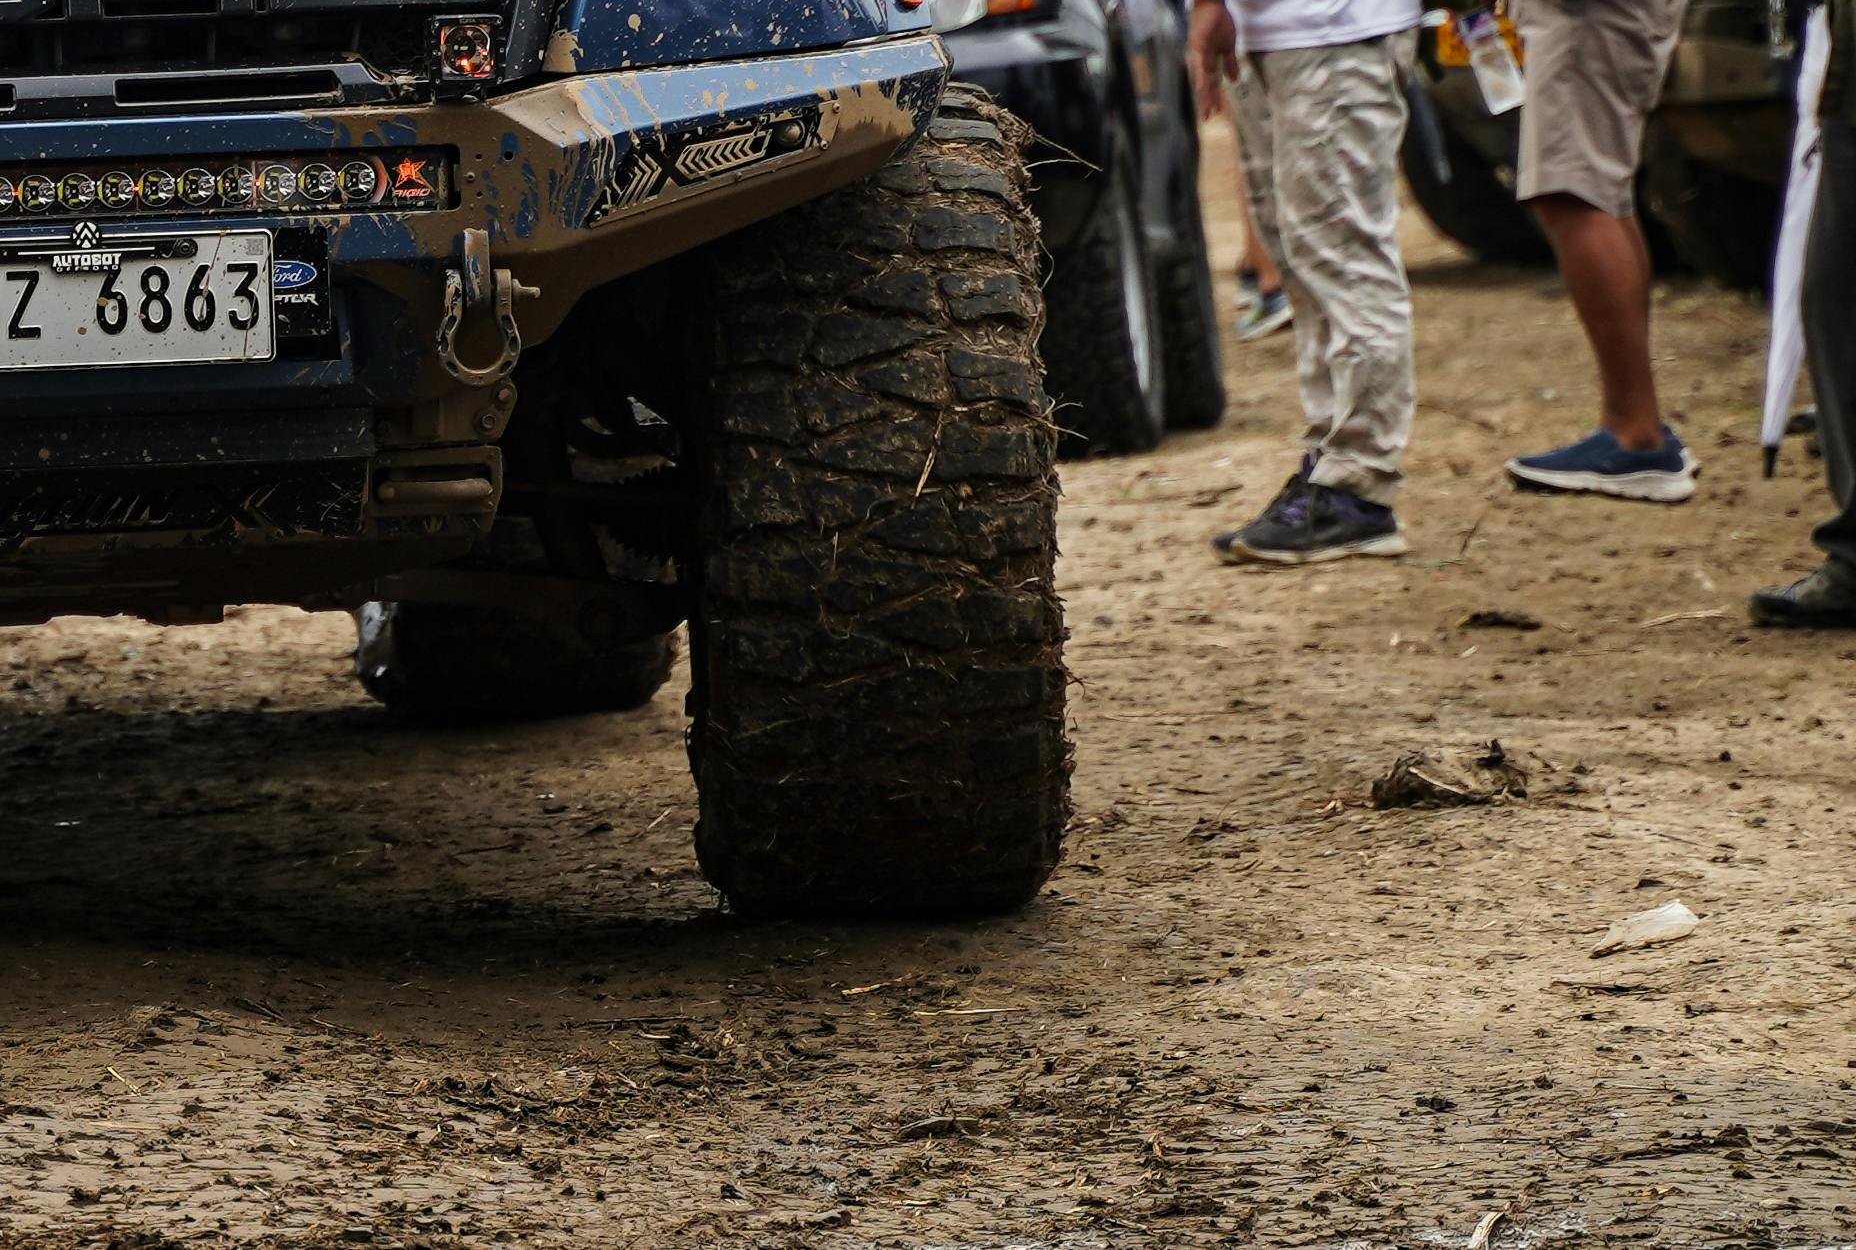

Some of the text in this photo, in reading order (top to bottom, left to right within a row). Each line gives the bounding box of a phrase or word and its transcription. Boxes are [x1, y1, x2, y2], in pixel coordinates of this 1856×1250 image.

[52, 253, 122, 267] AUTOBOT
[95, 263, 260, 335] 6863
[274, 293, 319, 306] PTOR
